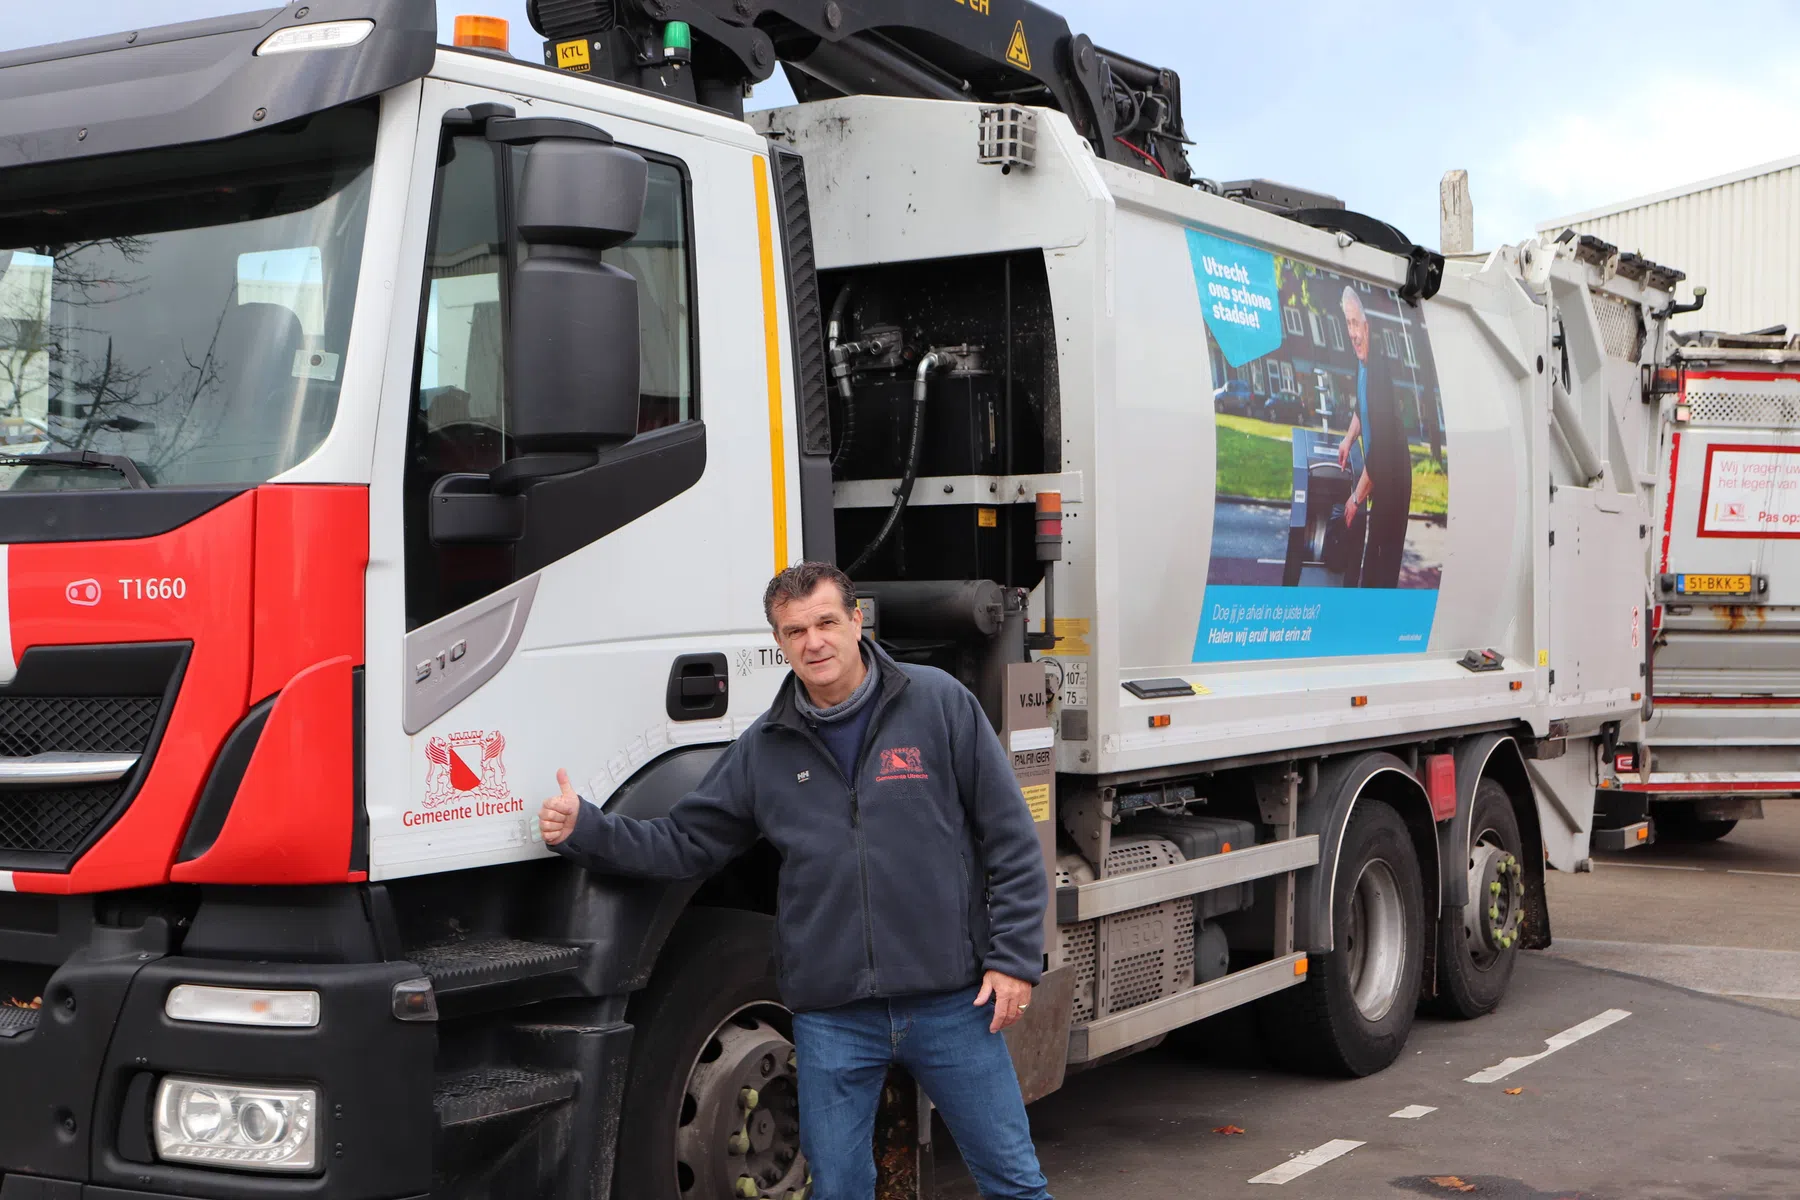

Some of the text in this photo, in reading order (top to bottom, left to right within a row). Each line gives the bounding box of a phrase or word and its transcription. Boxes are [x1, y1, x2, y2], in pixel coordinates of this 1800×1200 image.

[561, 46, 583, 59] KTL
[1202, 255, 1250, 285] Utrecht
[1208, 282, 1272, 311] ons schone
[1212, 301, 1260, 329] stadsie!
[1721, 461, 1738, 475] Wij
[1742, 463, 1782, 476] vragen
[1718, 477, 1797, 492] het legen van
[1758, 511, 1779, 523] Pas
[118, 577, 187, 600] T1660
[1689, 577, 1745, 590] 51-BKK-5
[1212, 604, 1230, 621] Doe
[1236, 604, 1245, 624] je
[1246, 604, 1265, 621] afval
[1264, 604, 1272, 620] in
[1272, 604, 1282, 620] de
[1282, 604, 1302, 623] juiste
[1302, 603, 1321, 620] bak?
[1208, 625, 1312, 646] Halen wij eruit wat erin zit
[415, 638, 467, 684] 310
[1066, 672, 1080, 685] 107
[1020, 693, 1045, 708] V.S.U.
[1066, 691, 1077, 704] 75
[1014, 751, 1050, 766] PALFINGER
[876, 774, 906, 782] Gemeente
[403, 797, 524, 827] Gemeente Utrecht
